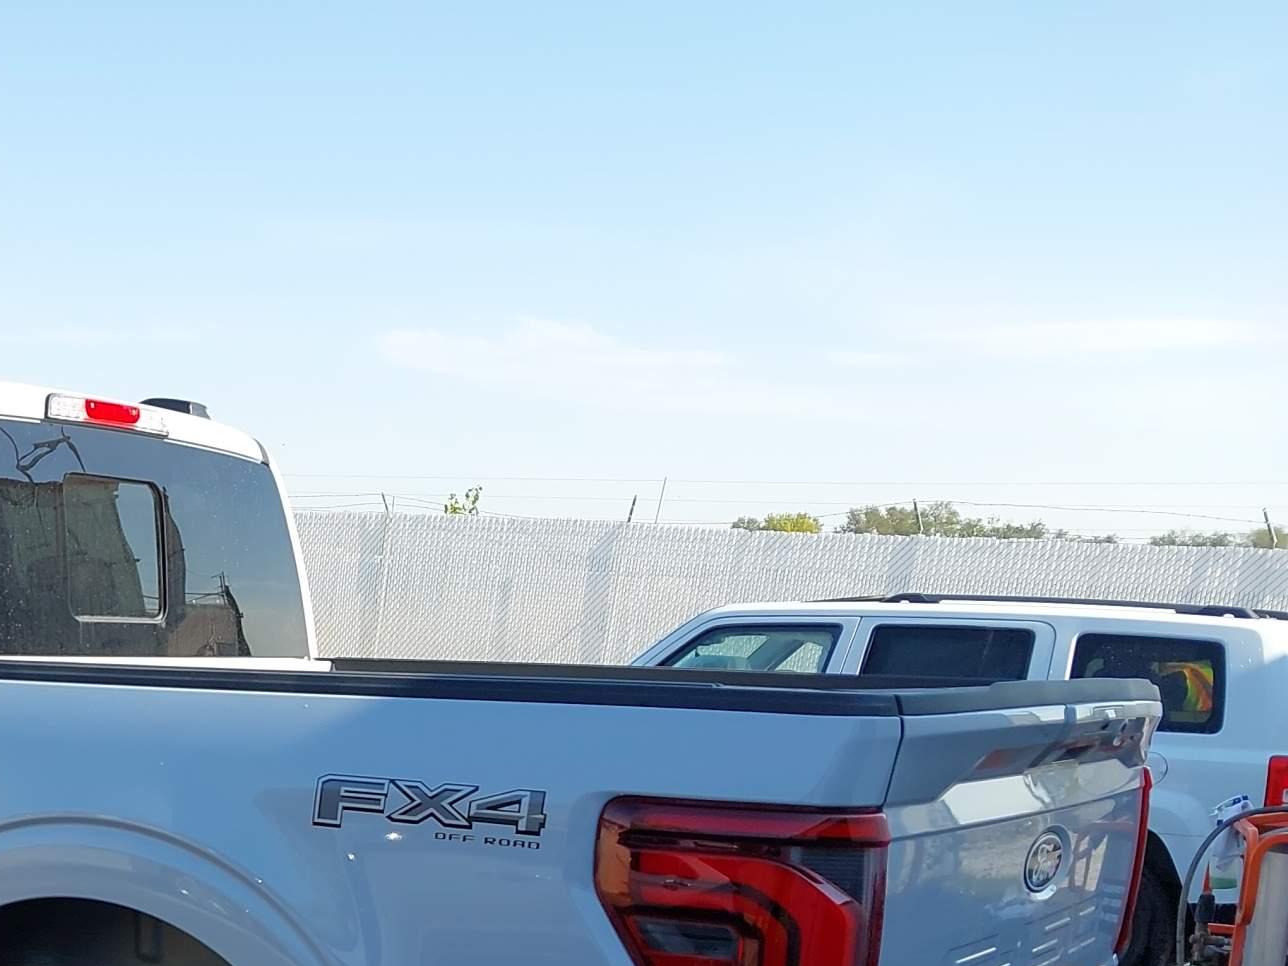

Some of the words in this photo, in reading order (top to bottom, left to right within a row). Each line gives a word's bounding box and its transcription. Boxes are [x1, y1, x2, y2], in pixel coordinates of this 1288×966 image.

[312, 773, 547, 837] FX4
[433, 831, 476, 843] OFF
[483, 836, 541, 850] ROAD
